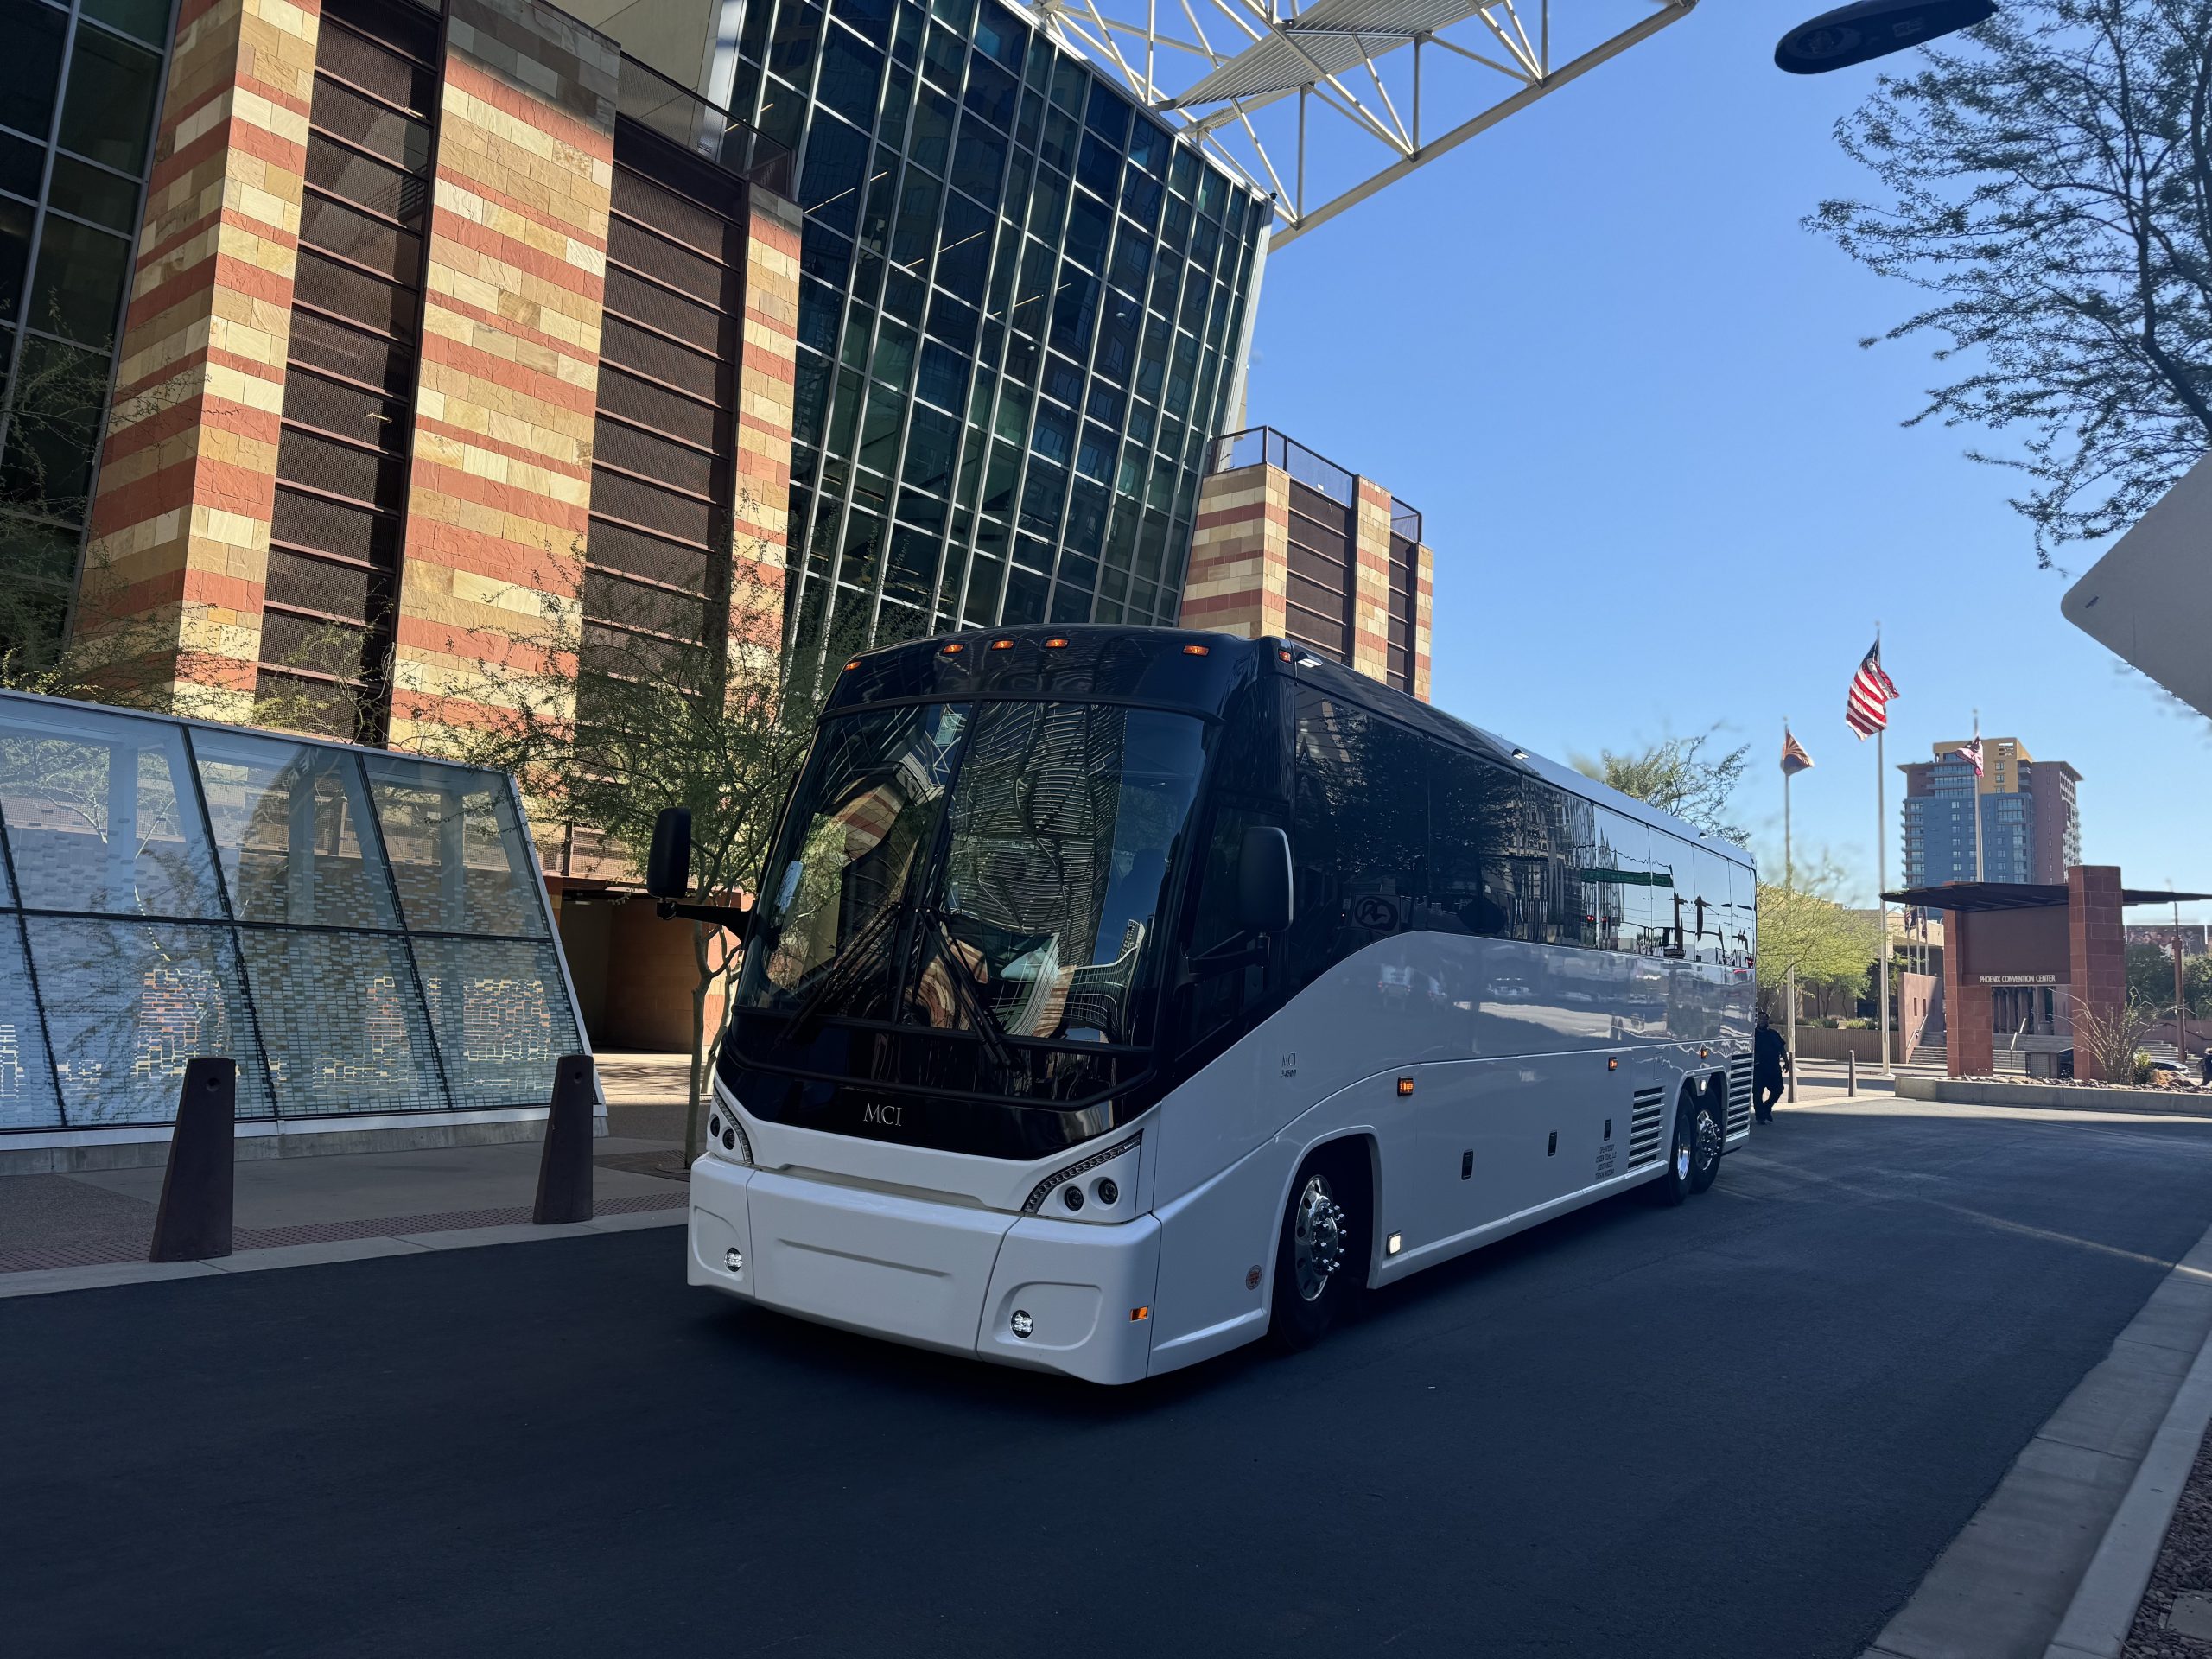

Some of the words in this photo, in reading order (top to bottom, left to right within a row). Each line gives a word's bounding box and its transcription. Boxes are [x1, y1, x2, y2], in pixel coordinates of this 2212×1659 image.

[1980, 975, 2001, 983] PHOENIX
[2035, 974, 2056, 982] CENTER
[1282, 1052, 1296, 1067] MCI
[863, 1103, 903, 1127] MCI
